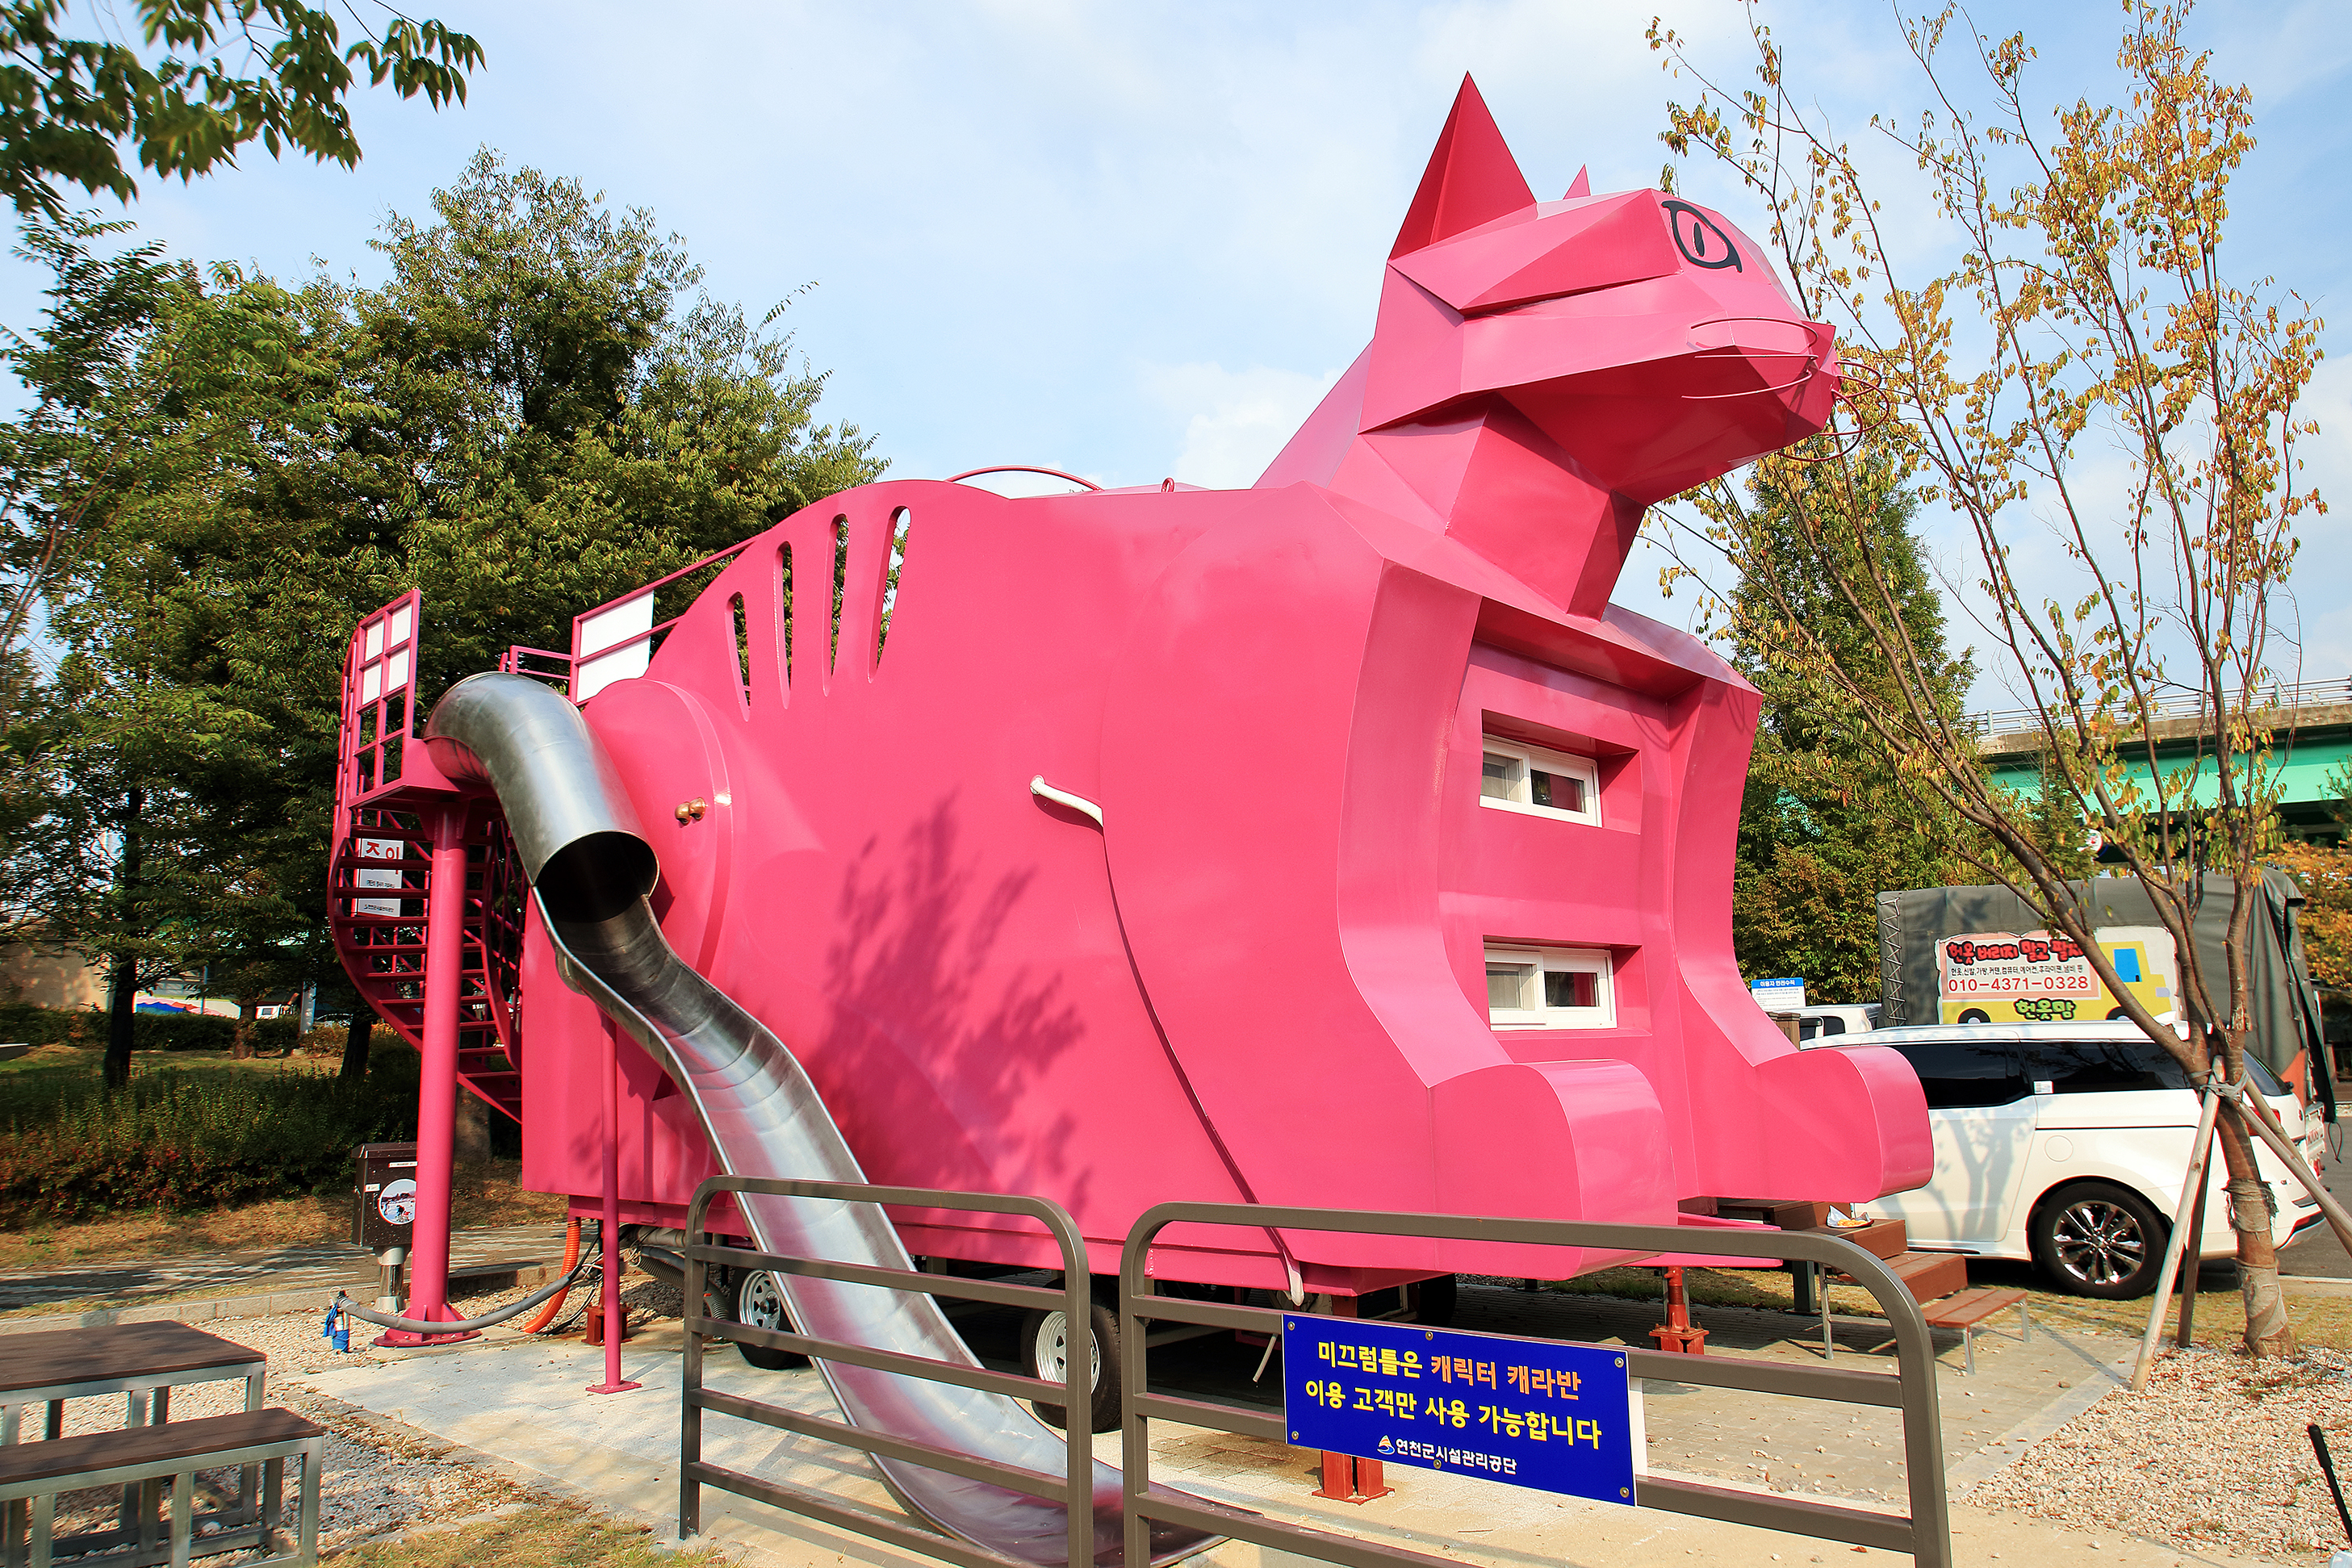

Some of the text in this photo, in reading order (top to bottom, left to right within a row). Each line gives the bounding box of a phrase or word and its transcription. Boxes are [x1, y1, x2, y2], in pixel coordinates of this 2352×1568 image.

[1947, 941, 1974, 965] 헌옷
[1975, 944, 2019, 960] 버리지
[2019, 939, 2049, 962] 말고
[1948, 976, 2088, 992] 010-4371-0328
[2015, 998, 2076, 1021] 헌옷맘
[1318, 1341, 1582, 1400] 미끄럼틀은 캐릭터 캐라반
[1305, 1379, 1602, 1450] 이용 고객만 사용 가능합니다
[1396, 1438, 1517, 1475] 연천군시설관리공단
